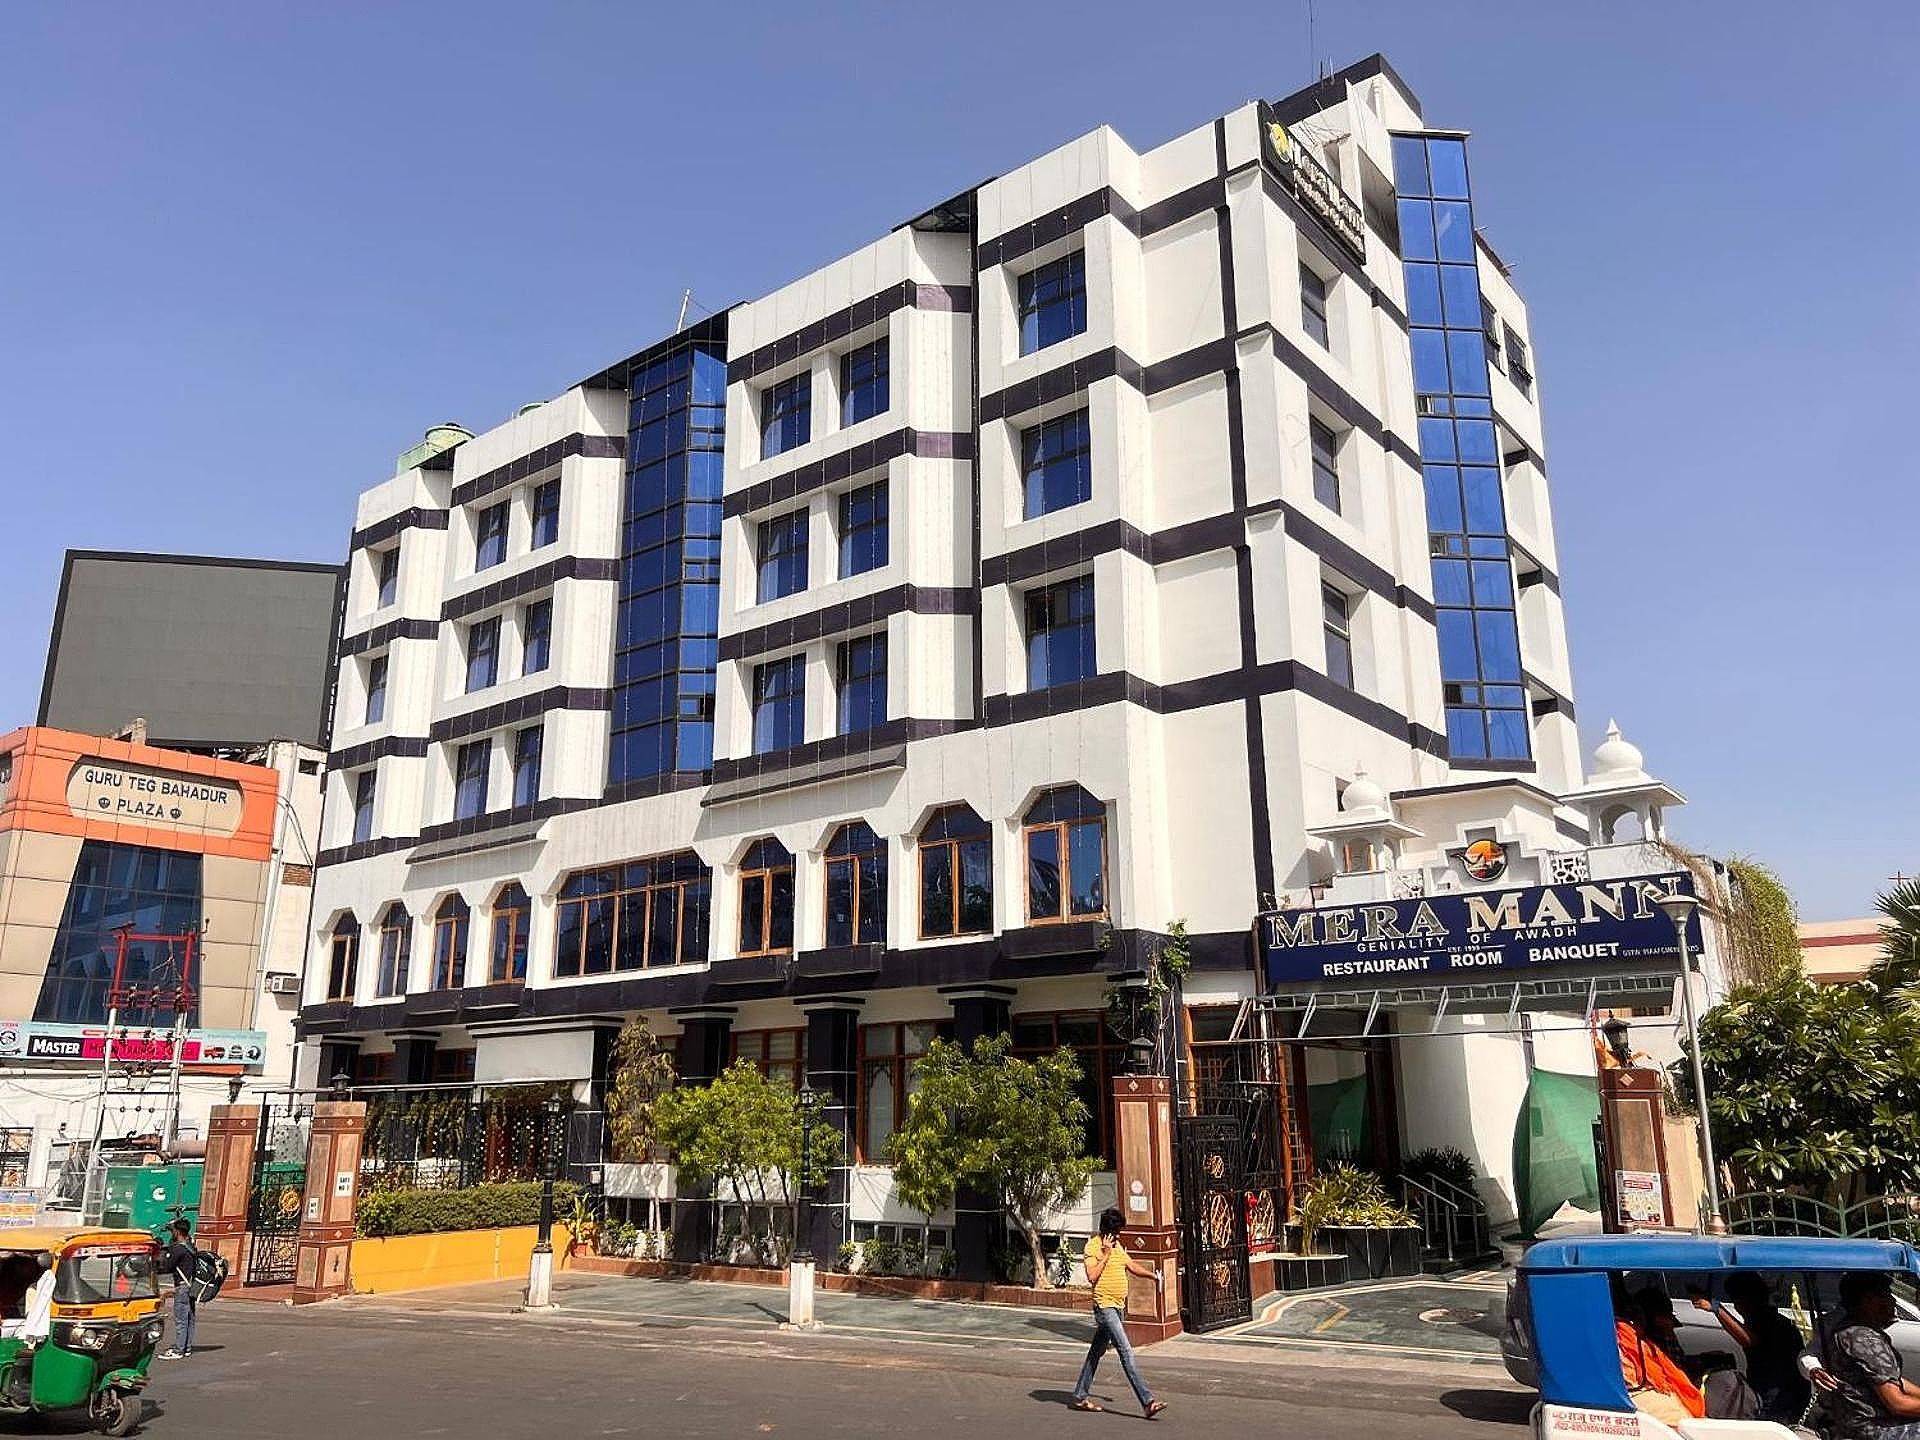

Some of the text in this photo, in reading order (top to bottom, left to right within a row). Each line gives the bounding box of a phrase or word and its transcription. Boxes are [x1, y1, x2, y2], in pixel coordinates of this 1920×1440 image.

[85, 769, 228, 804] GURU TEG BAHADUR
[117, 799, 165, 818] PLAZA
[1267, 877, 1681, 949] MERA MANN
[1357, 926, 1577, 953] GENIALITY OF AWADH
[1323, 956, 1430, 976] RESTAURANT
[1450, 951, 1503, 967] ROOM
[1529, 942, 1619, 962] BANQUET
[32, 1039, 80, 1054] MASTER
